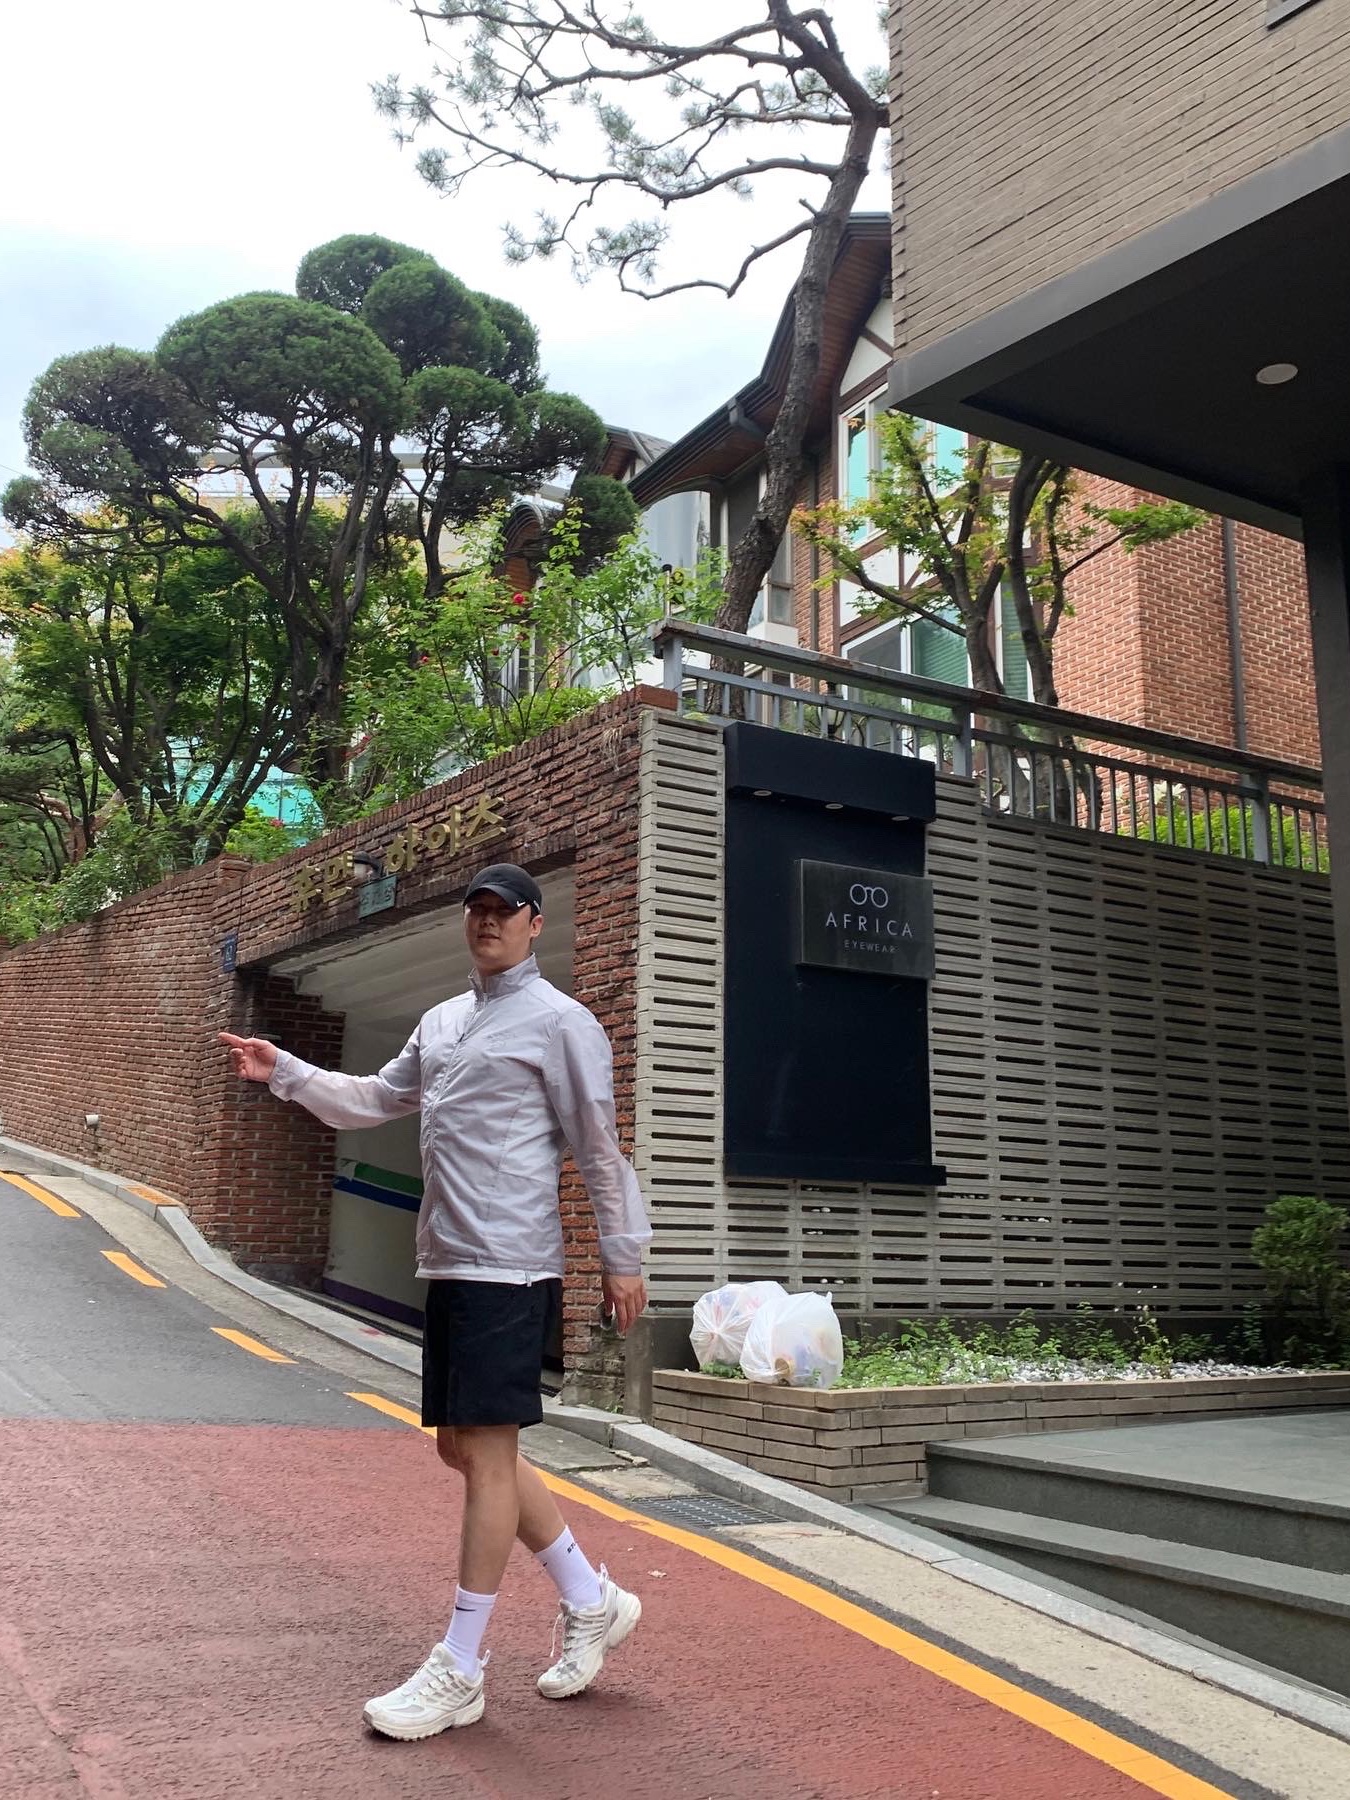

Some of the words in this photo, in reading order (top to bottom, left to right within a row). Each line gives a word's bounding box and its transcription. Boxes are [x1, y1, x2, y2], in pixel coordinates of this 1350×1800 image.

[385, 794, 507, 872] 하이츠
[825, 911, 913, 938] AFRICA
[844, 939, 898, 953] EYEWEAR
